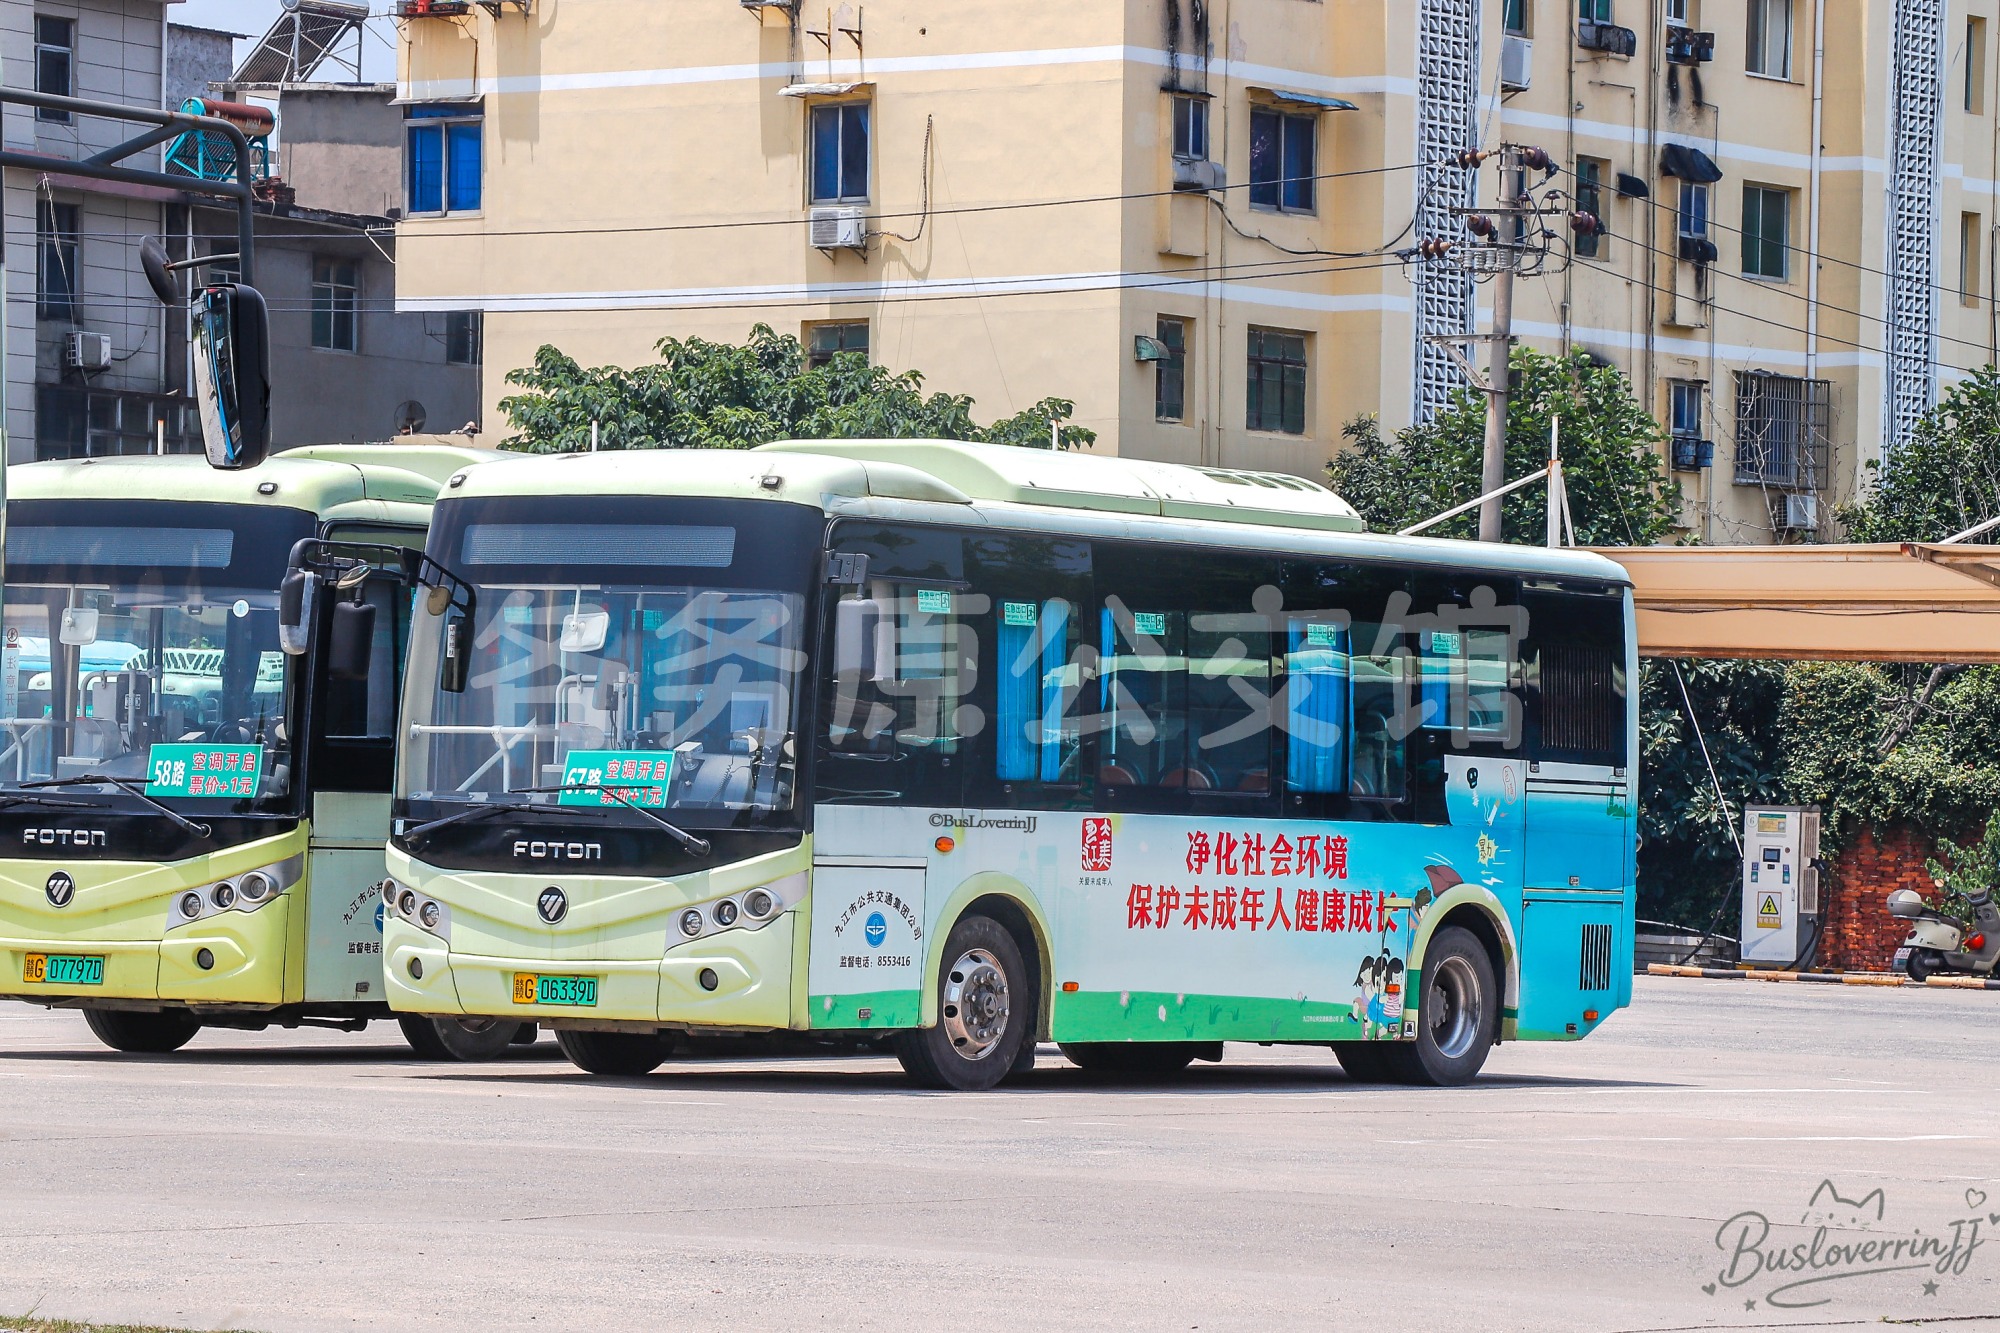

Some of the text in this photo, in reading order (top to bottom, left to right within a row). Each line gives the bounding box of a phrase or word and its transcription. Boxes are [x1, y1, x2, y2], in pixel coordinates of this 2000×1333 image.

[192, 752, 255, 771] 空调开启
[605, 760, 667, 780] 空调开启
[153, 760, 186, 787] 58路
[188, 775, 253, 794] 票价+1元
[565, 767, 602, 795] 67路
[23, 828, 106, 846] FOTON
[513, 841, 601, 859] FOTON
[1185, 831, 1348, 879] 净化社会环境
[834, 889, 922, 941] 九江市公共交通集团公司
[1127, 883, 1399, 934] 保护未成年人健康成长
